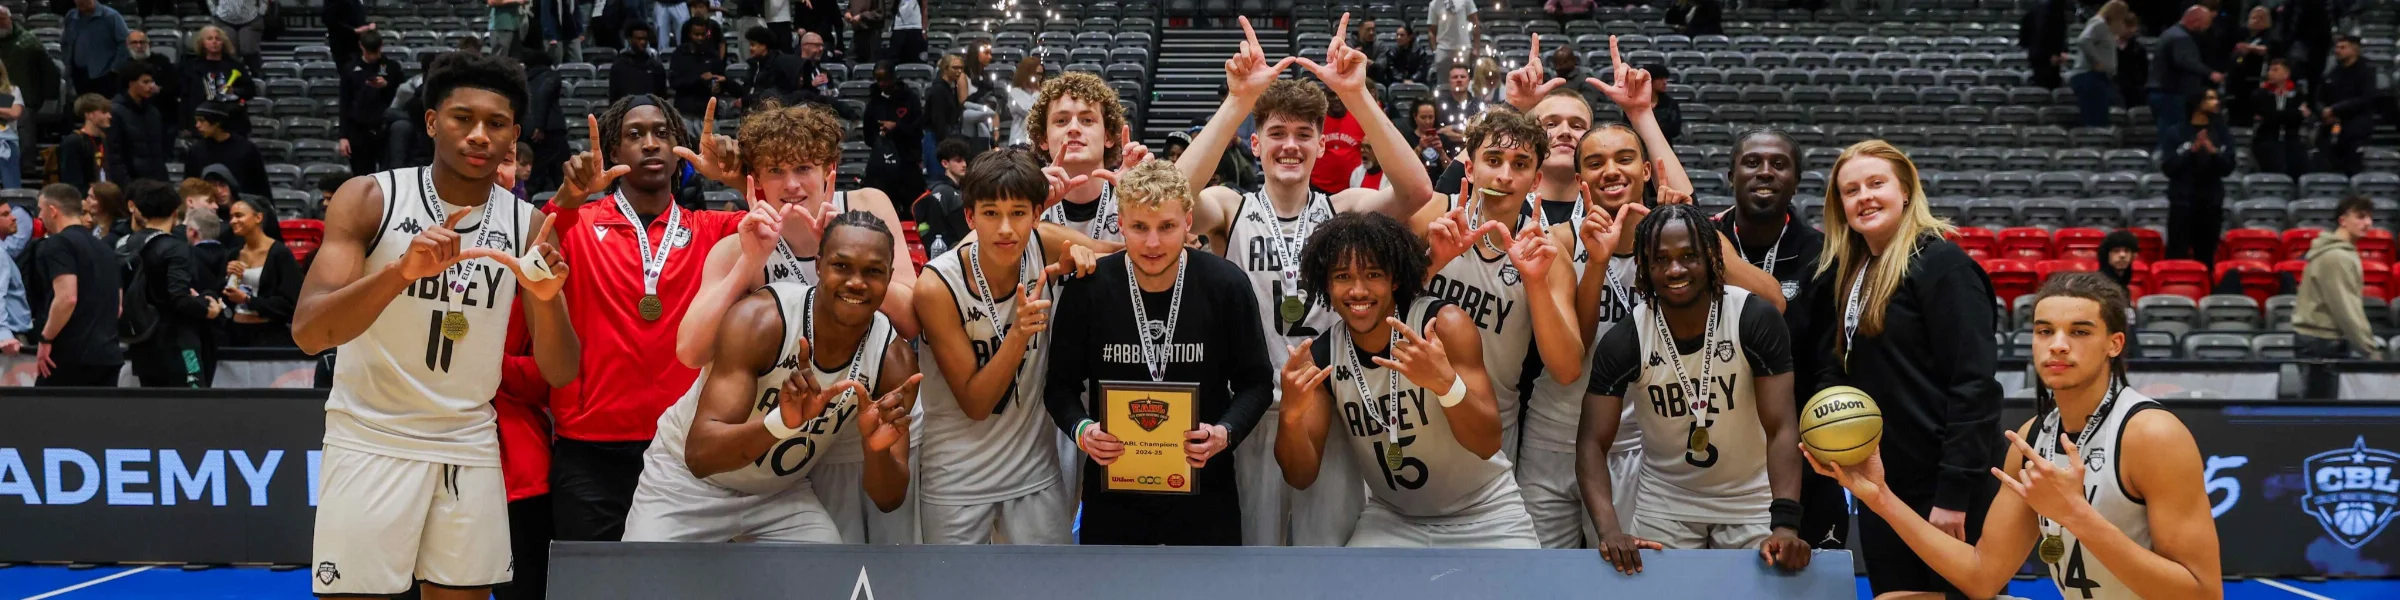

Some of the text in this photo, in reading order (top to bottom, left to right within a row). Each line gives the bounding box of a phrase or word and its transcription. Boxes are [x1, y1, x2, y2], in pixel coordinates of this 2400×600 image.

[429, 194, 445, 226] BASKET
[655, 250, 666, 268] ELITE
[663, 223, 675, 251] ACADEMY
[1271, 219, 1285, 249] ACADEMY
[461, 261, 475, 281] ELITE
[475, 225, 489, 248] DEMY
[641, 236, 651, 264] LEAGUE
[1280, 249, 1290, 268] ELITE
[1291, 240, 1302, 266] LEAGUE
[971, 244, 983, 280] ACADEMY
[978, 280, 998, 325] BASKETBALL
[1611, 276, 1627, 303] LEAGUE
[1847, 295, 1857, 321] LEAGUE
[1132, 288, 1149, 336] BASKETBALL
[1143, 336, 1155, 365] LEAGUE
[1165, 308, 1177, 345] ACADEMY
[1660, 328, 1682, 373] BASKETBALL
[1678, 371, 1695, 399] LEAGUE
[1703, 337, 1713, 375] ACADEMY
[1348, 349, 1368, 394] BASKETBALL
[1364, 394, 1380, 419] LEAGUE
[1701, 375, 1709, 396] ELITE
[1813, 399, 1865, 420] Wilson
[1139, 441, 1179, 449] Champions
[1373, 435, 1429, 492] 15
[2315, 465, 2400, 493] CBL
